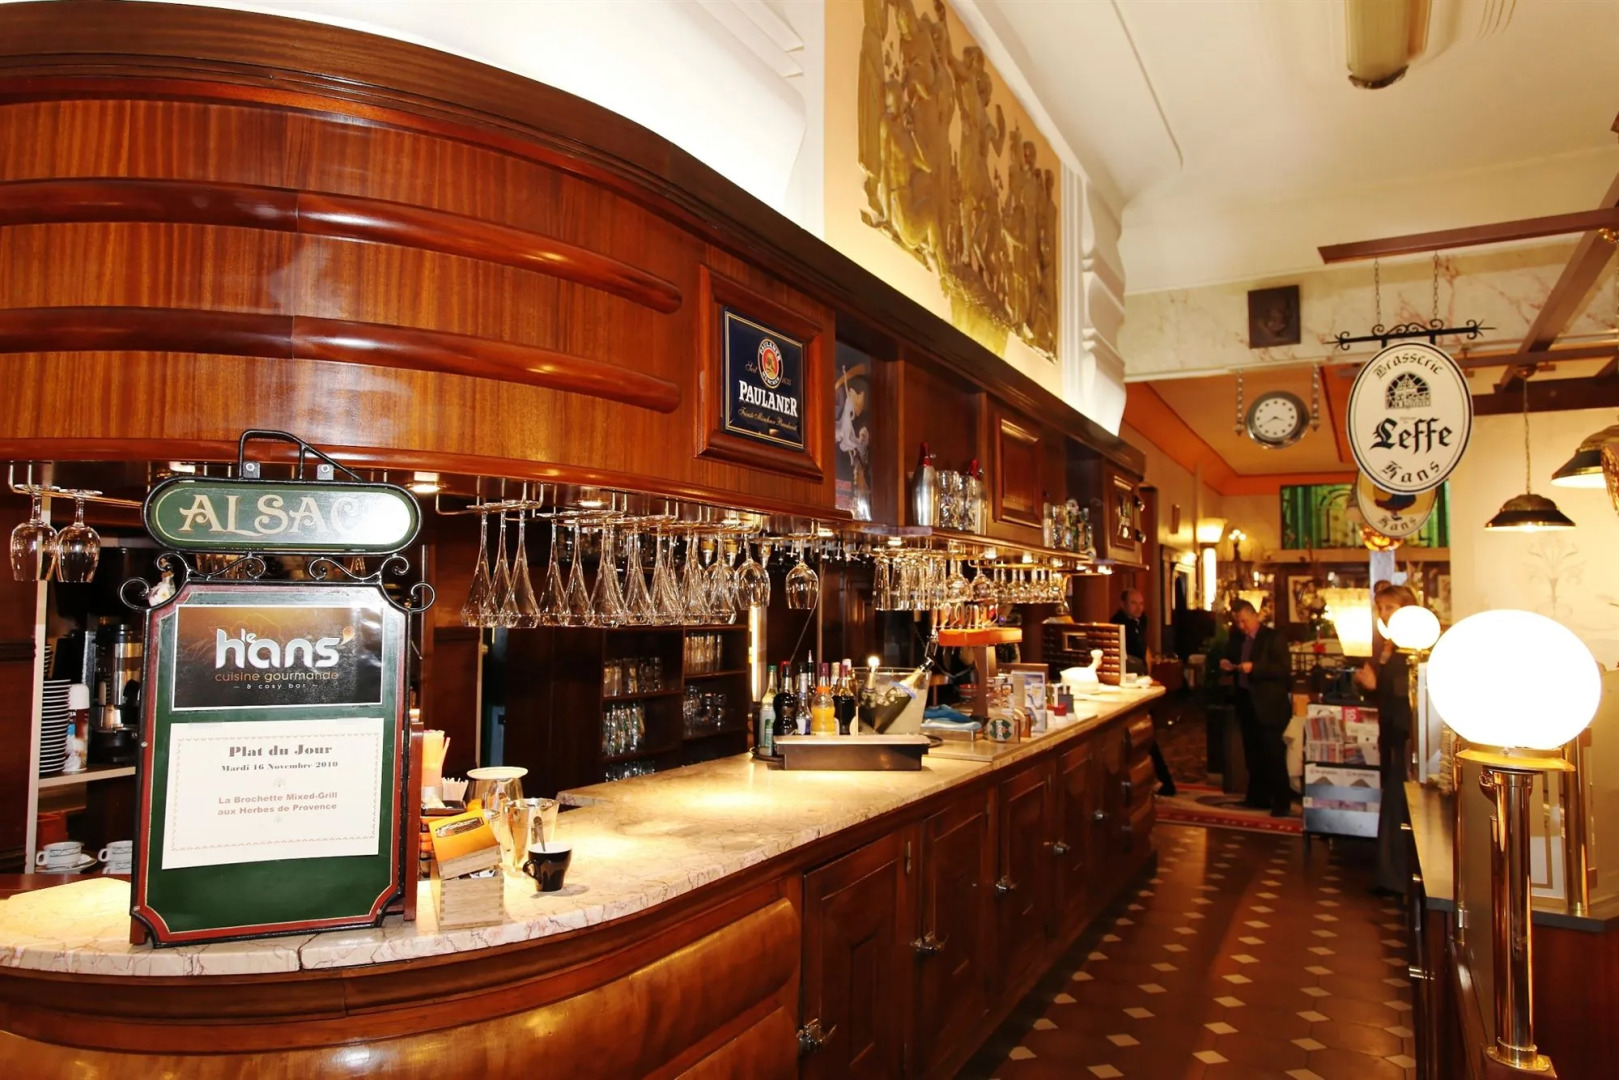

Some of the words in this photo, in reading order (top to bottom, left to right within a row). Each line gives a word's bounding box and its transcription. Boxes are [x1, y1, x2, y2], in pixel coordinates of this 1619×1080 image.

[1373, 353, 1443, 379] Brasserie
[738, 379, 798, 417] PAULANER
[1369, 417, 1453, 455] Leffe
[178, 494, 362, 537] ALSAC
[214, 671, 260, 682] cuisine
[264, 671, 339, 683] gourmande
[229, 746, 263, 757] Plat
[268, 745, 289, 756] du
[294, 744, 333, 755] Jour
[221, 764, 250, 772] Mardi
[253, 763, 265, 771] 16
[268, 762, 312, 770] Novembre
[218, 797, 231, 805] La
[233, 794, 283, 804] Brochette
[286, 792, 338, 801] Mixed-Grill
[239, 806, 275, 815] Herbes
[292, 803, 337, 812] Provence
